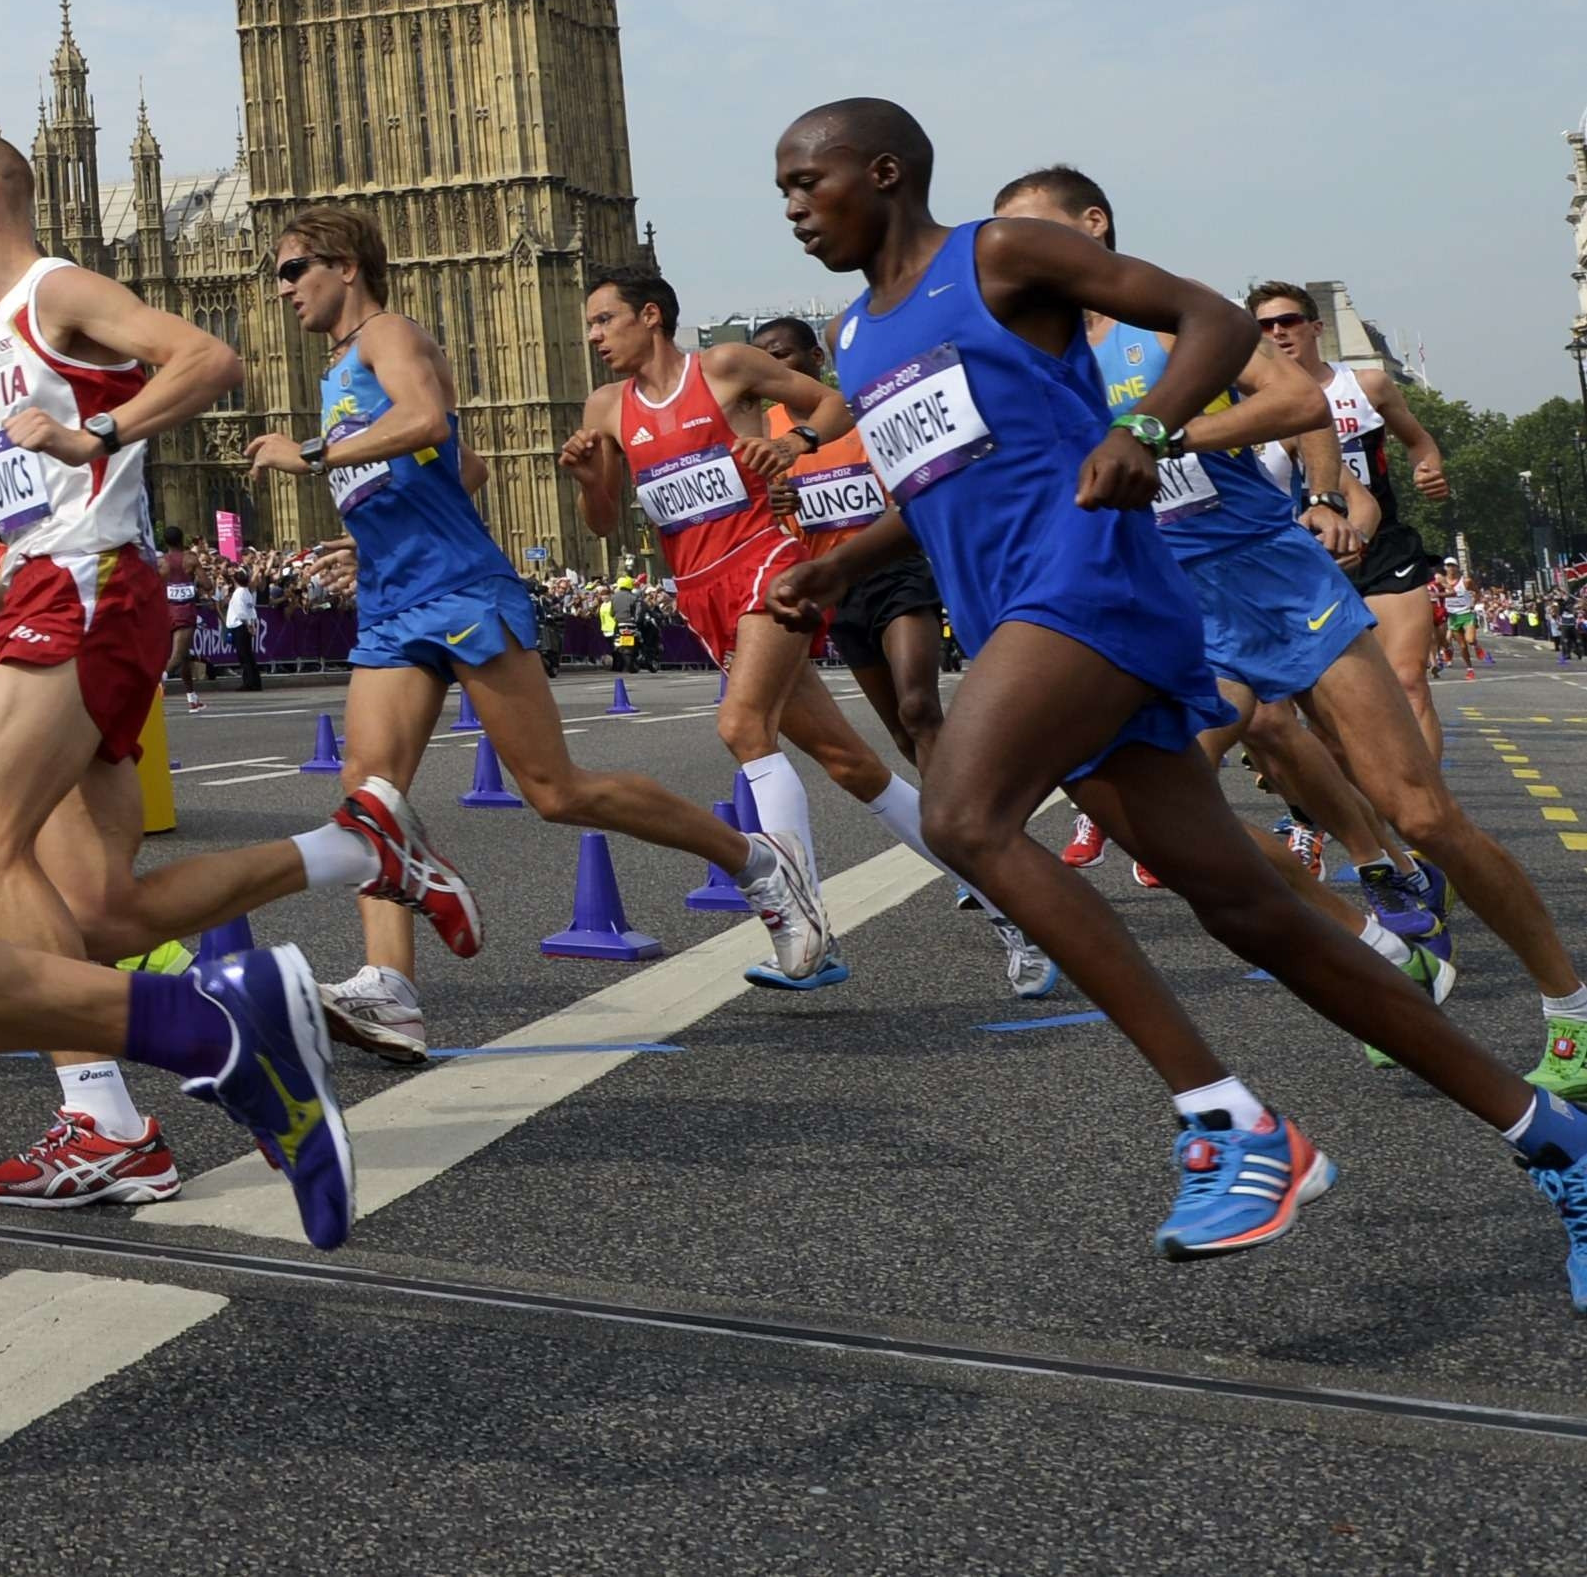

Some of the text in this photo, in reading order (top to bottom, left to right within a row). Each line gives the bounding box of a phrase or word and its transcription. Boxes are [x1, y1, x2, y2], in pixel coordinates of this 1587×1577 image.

[859, 363, 922, 410] London 2012
[870, 390, 956, 472] RAMONENE
[651, 453, 702, 478] London 2012
[802, 467, 852, 485] London 2012
[647, 466, 734, 520] WEIDLINGER
